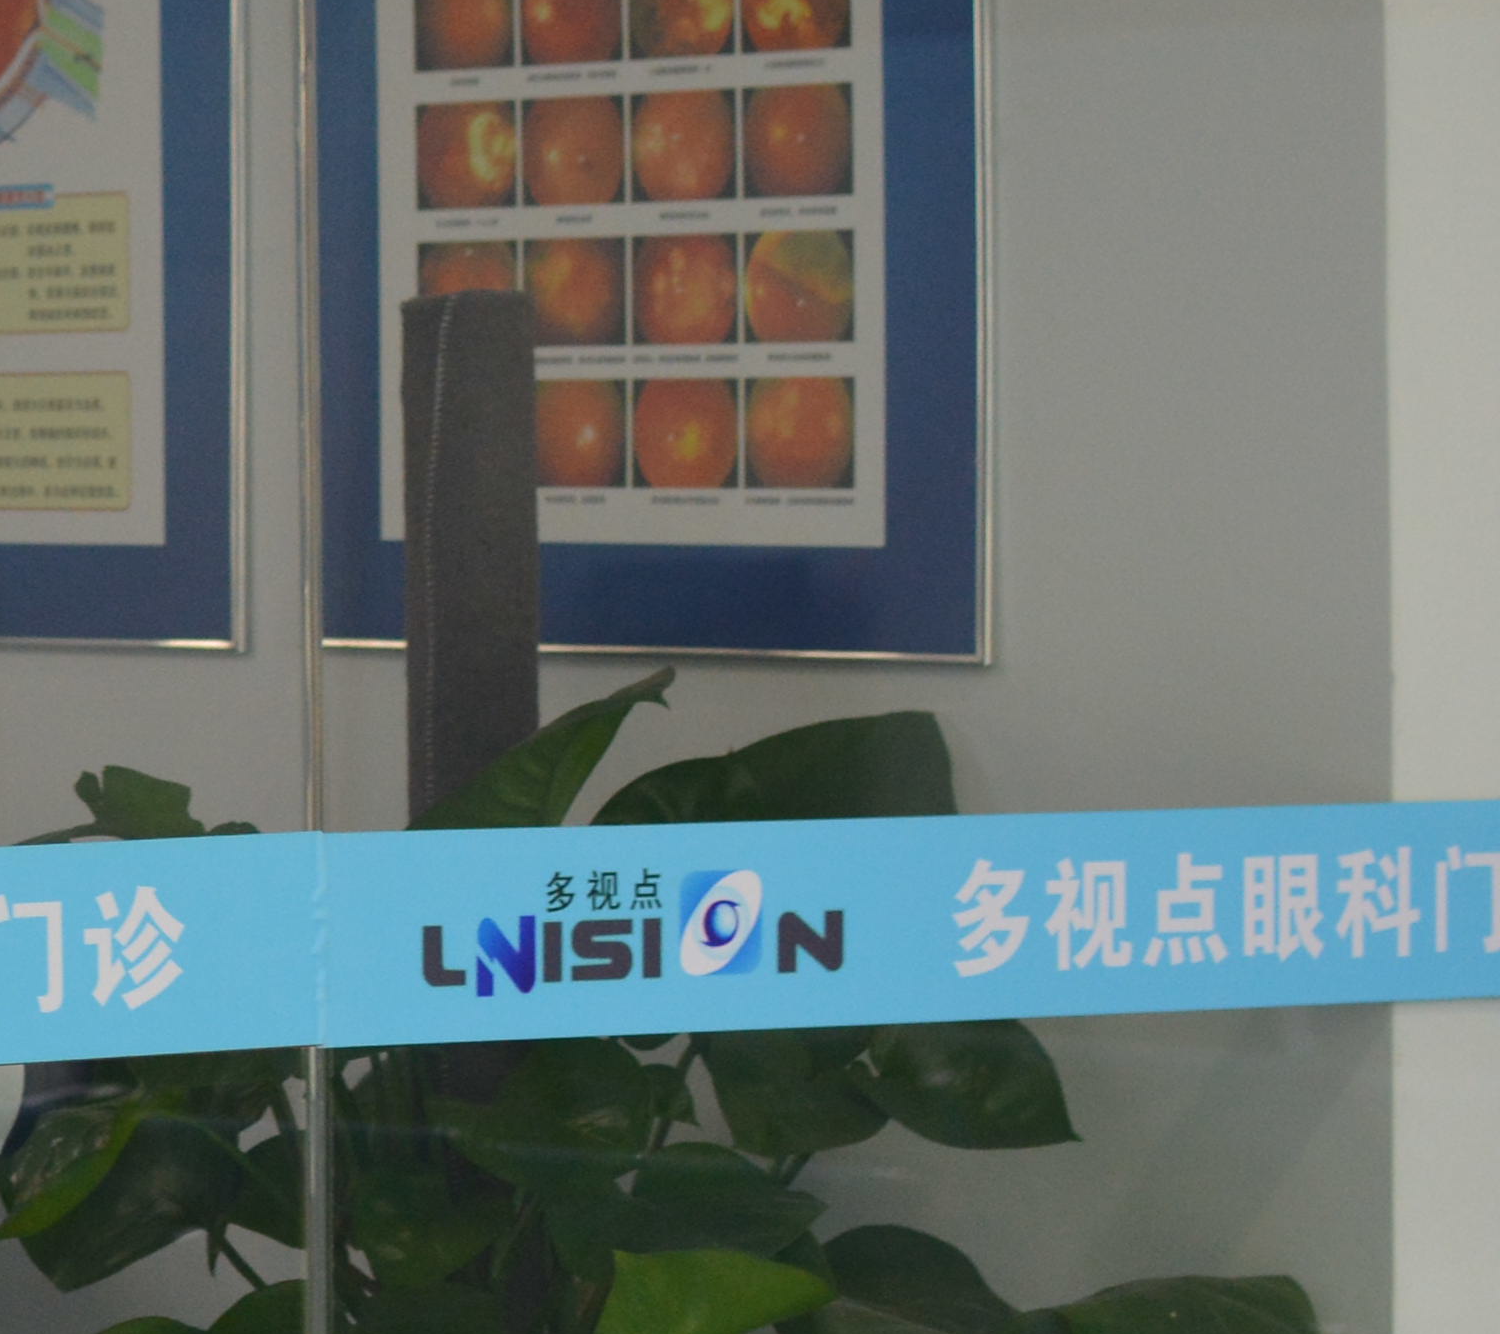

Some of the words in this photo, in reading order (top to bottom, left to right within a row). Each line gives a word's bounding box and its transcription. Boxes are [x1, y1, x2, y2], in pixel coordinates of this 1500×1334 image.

[545, 868, 663, 912] 多视点
[953, 844, 1500, 978] 多视点眼科门
